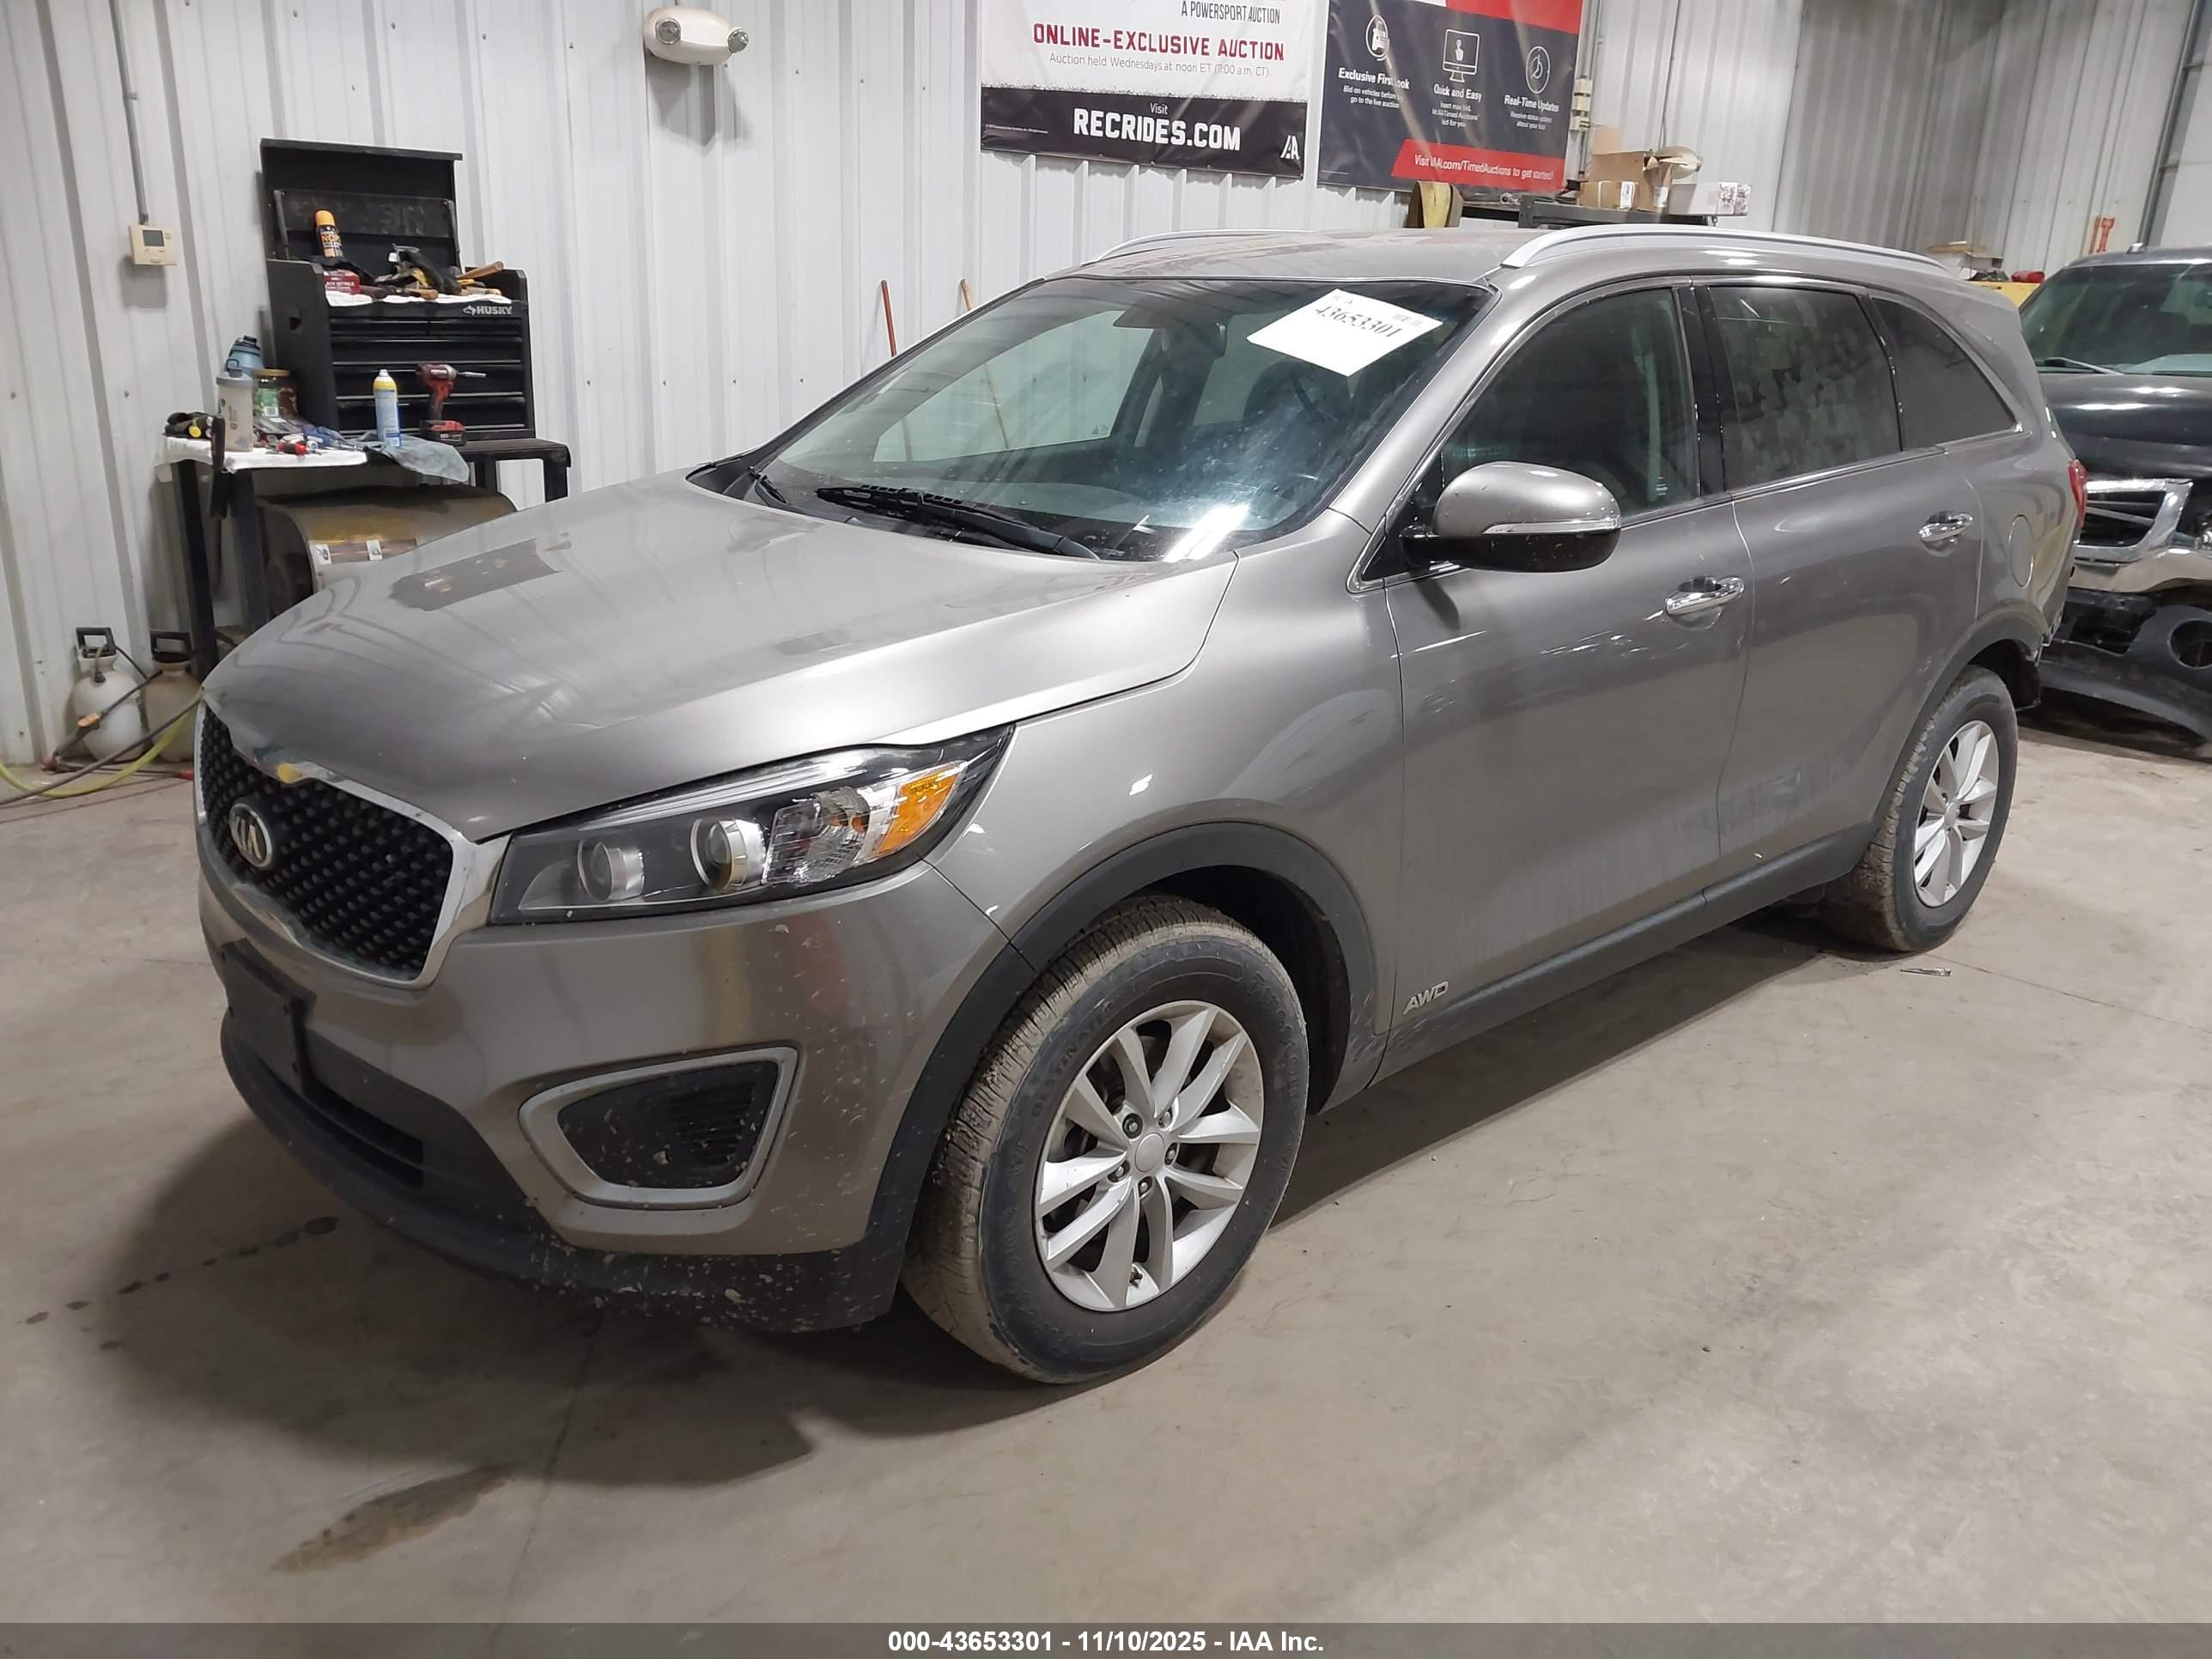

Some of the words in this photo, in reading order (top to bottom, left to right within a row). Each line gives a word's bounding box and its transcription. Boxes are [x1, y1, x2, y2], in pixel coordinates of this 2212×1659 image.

[1181, 0, 1188, 16] A
[1190, 1, 1248, 21] POWERSPORT
[1248, 6, 1280, 25] AUCTION
[1033, 23, 1210, 57] ONLINE-EXCLUSIVE
[1217, 39, 1285, 61] AUCTION
[1049, 52, 1085, 65] Auction
[1087, 55, 1108, 67] held
[1110, 57, 1163, 73] Wednesdays
[1164, 62, 1173, 71] at
[1175, 64, 1198, 73] noon
[1200, 63, 1212, 73] ET
[1338, 67, 1376, 83] Exclusive
[1433, 83, 1451, 96] Quick
[1451, 88, 1465, 98] and
[1465, 88, 1483, 103] Easy
[1504, 94, 1537, 109] Real-Time
[1149, 102, 1169, 116] Visit
[1073, 107, 1242, 152] RECRIDES.COM
[1414, 155, 1430, 167] Visit
[1512, 167, 1521, 177] to
[1521, 168, 1533, 180] get
[476, 306, 514, 315] HUSKY
[1315, 306, 1402, 337] 43653301
[1402, 981, 1449, 1015] AWD
